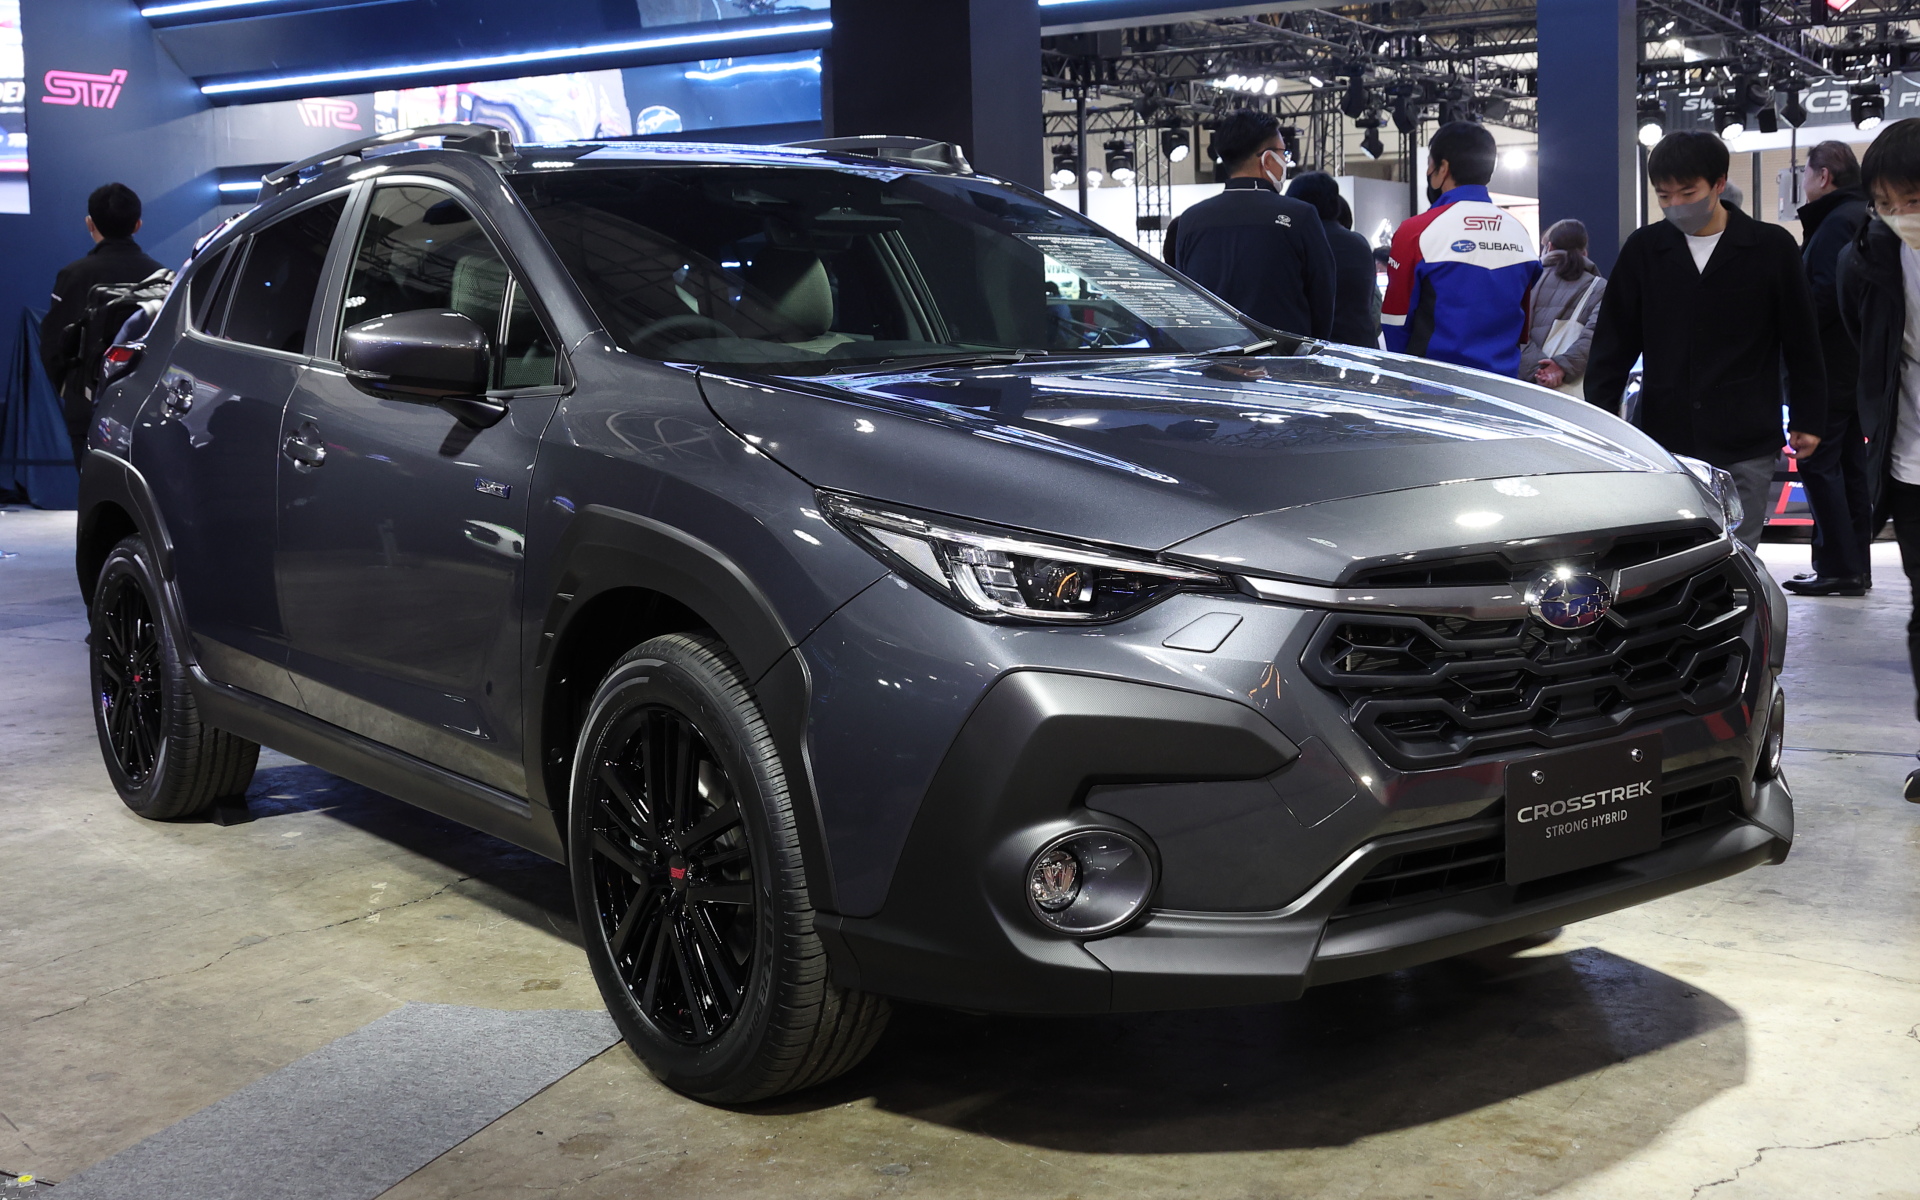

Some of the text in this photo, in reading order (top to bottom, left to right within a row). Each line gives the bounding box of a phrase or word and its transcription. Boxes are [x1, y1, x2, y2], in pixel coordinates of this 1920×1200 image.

[1478, 241, 1524, 253] SUBARU
[1517, 779, 1653, 823] CROSSTREK
[1545, 809, 1628, 839] STRONG HYBRID
